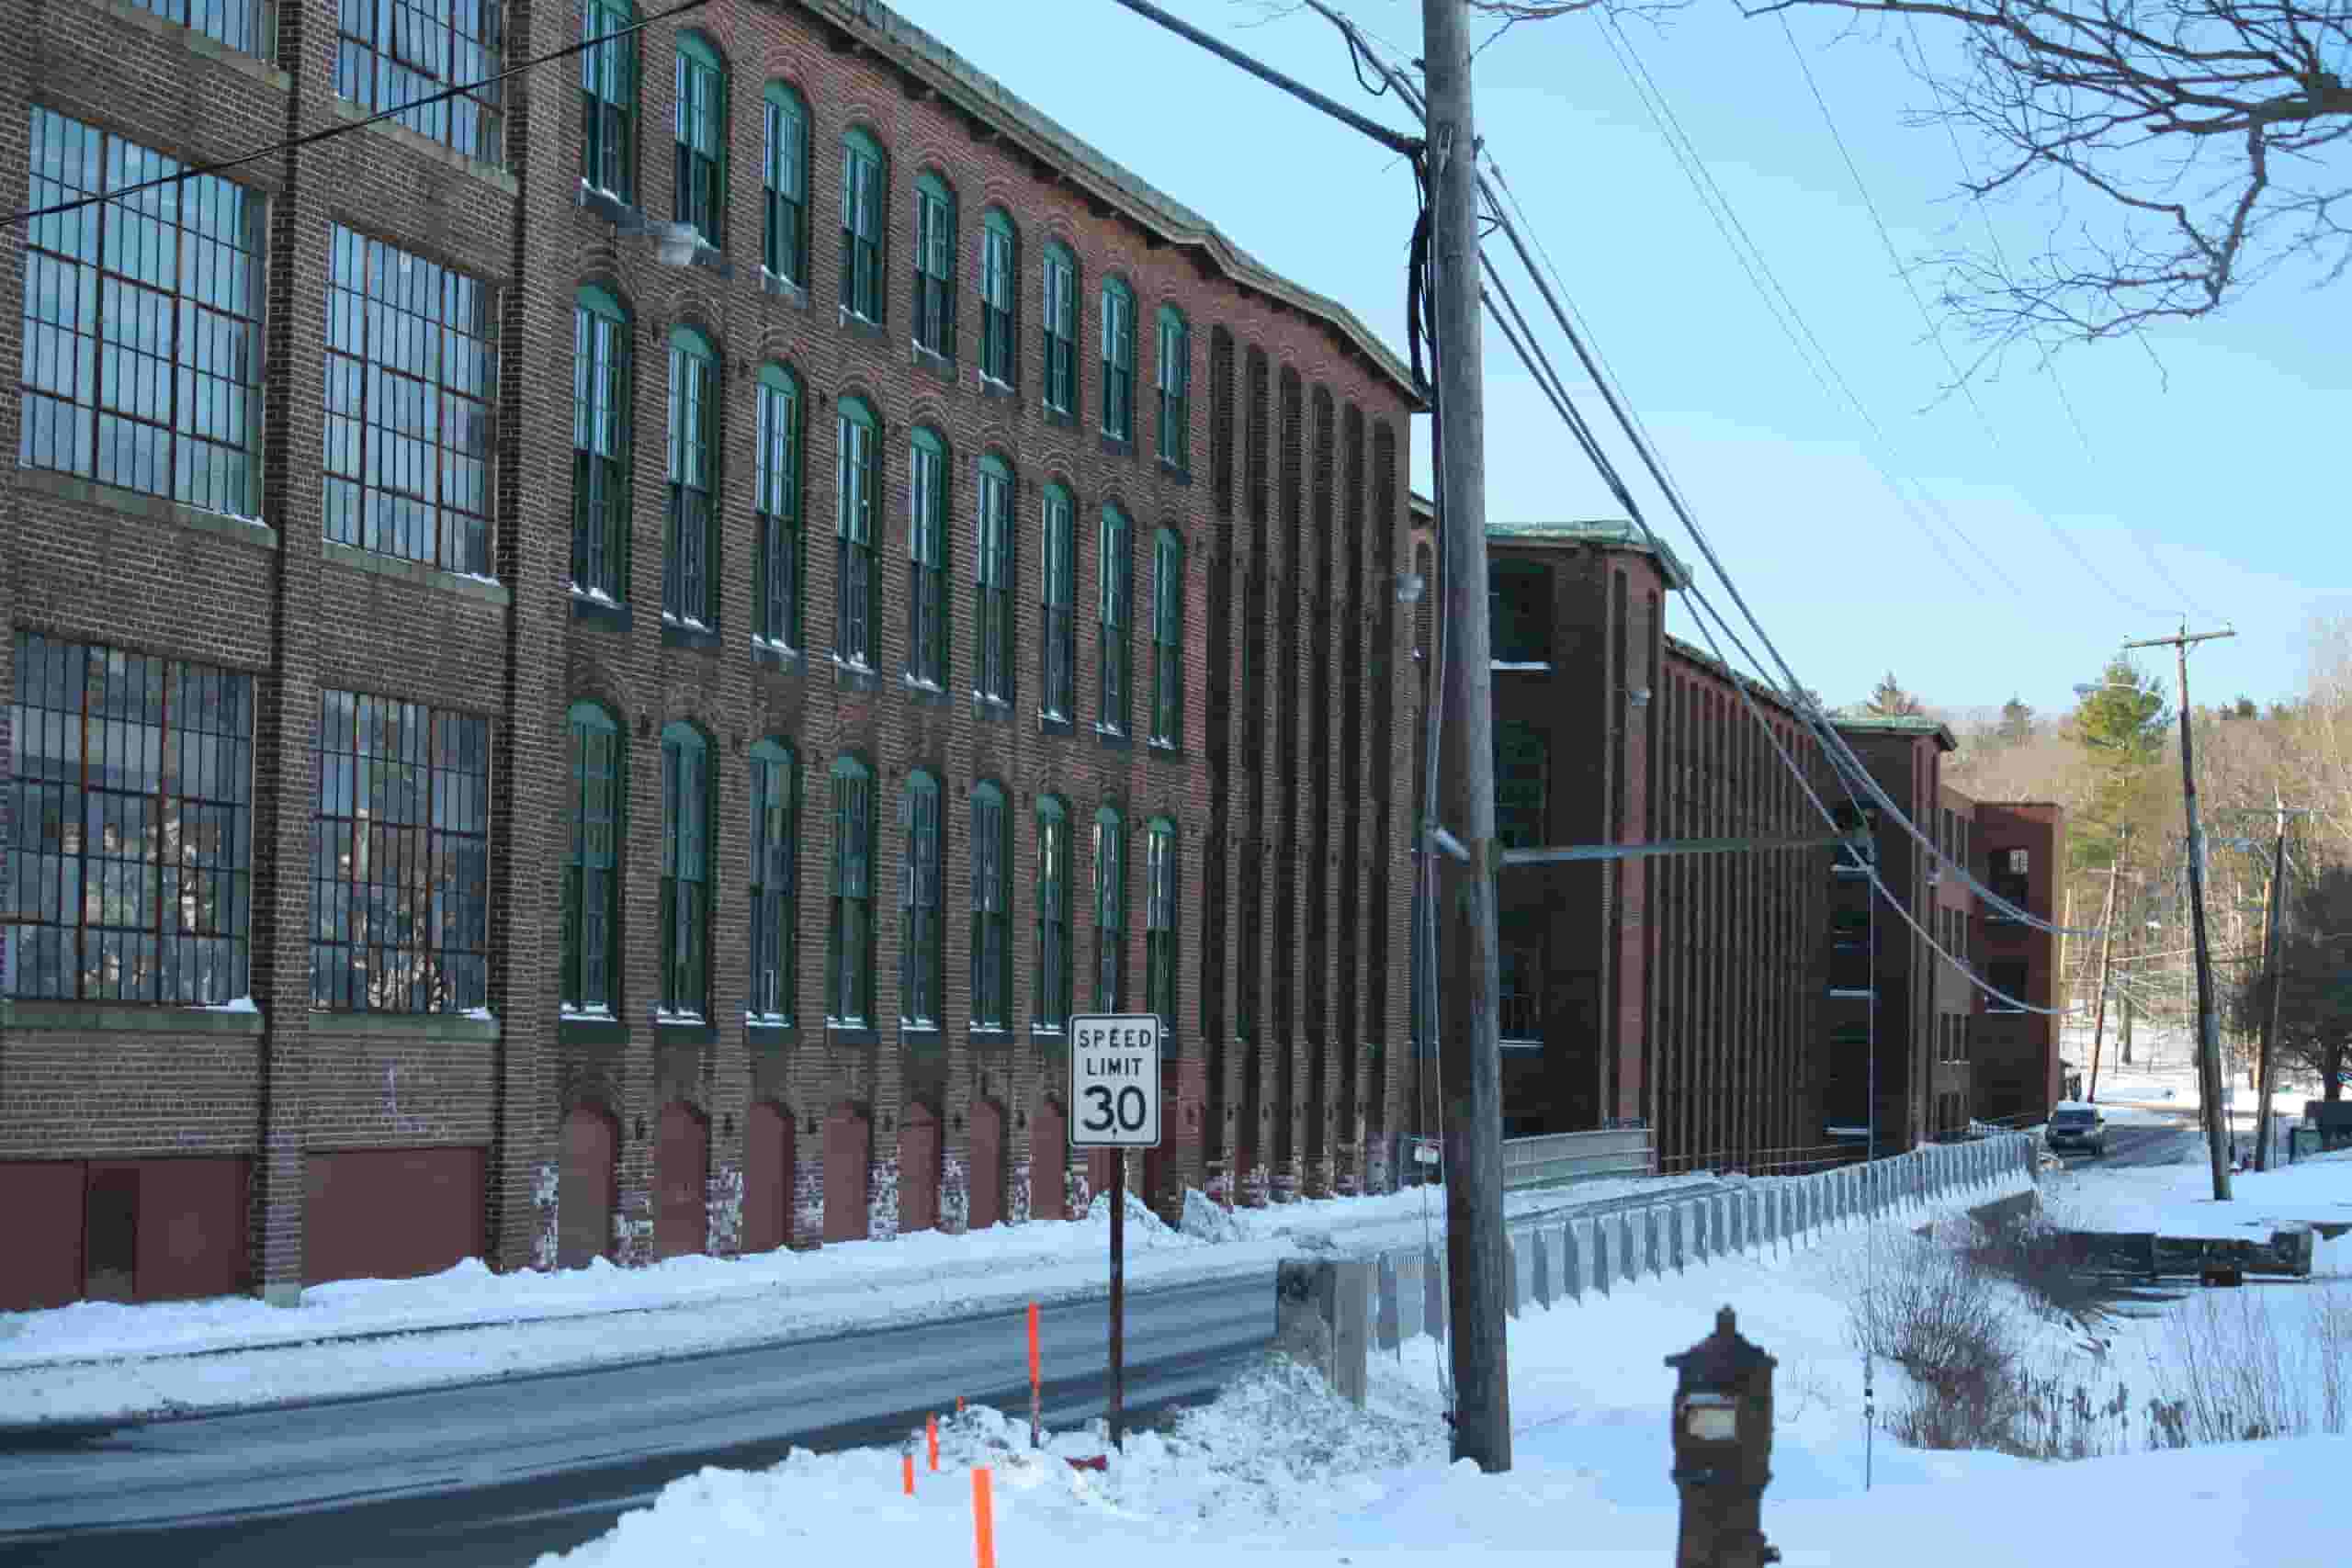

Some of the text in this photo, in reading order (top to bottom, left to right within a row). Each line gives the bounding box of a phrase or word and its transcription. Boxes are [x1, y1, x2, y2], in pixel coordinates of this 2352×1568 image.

[1079, 1029, 1151, 1048] SPEED
[1087, 1058, 1143, 1076] LIMIT
[1082, 1085, 1147, 1132] 30
